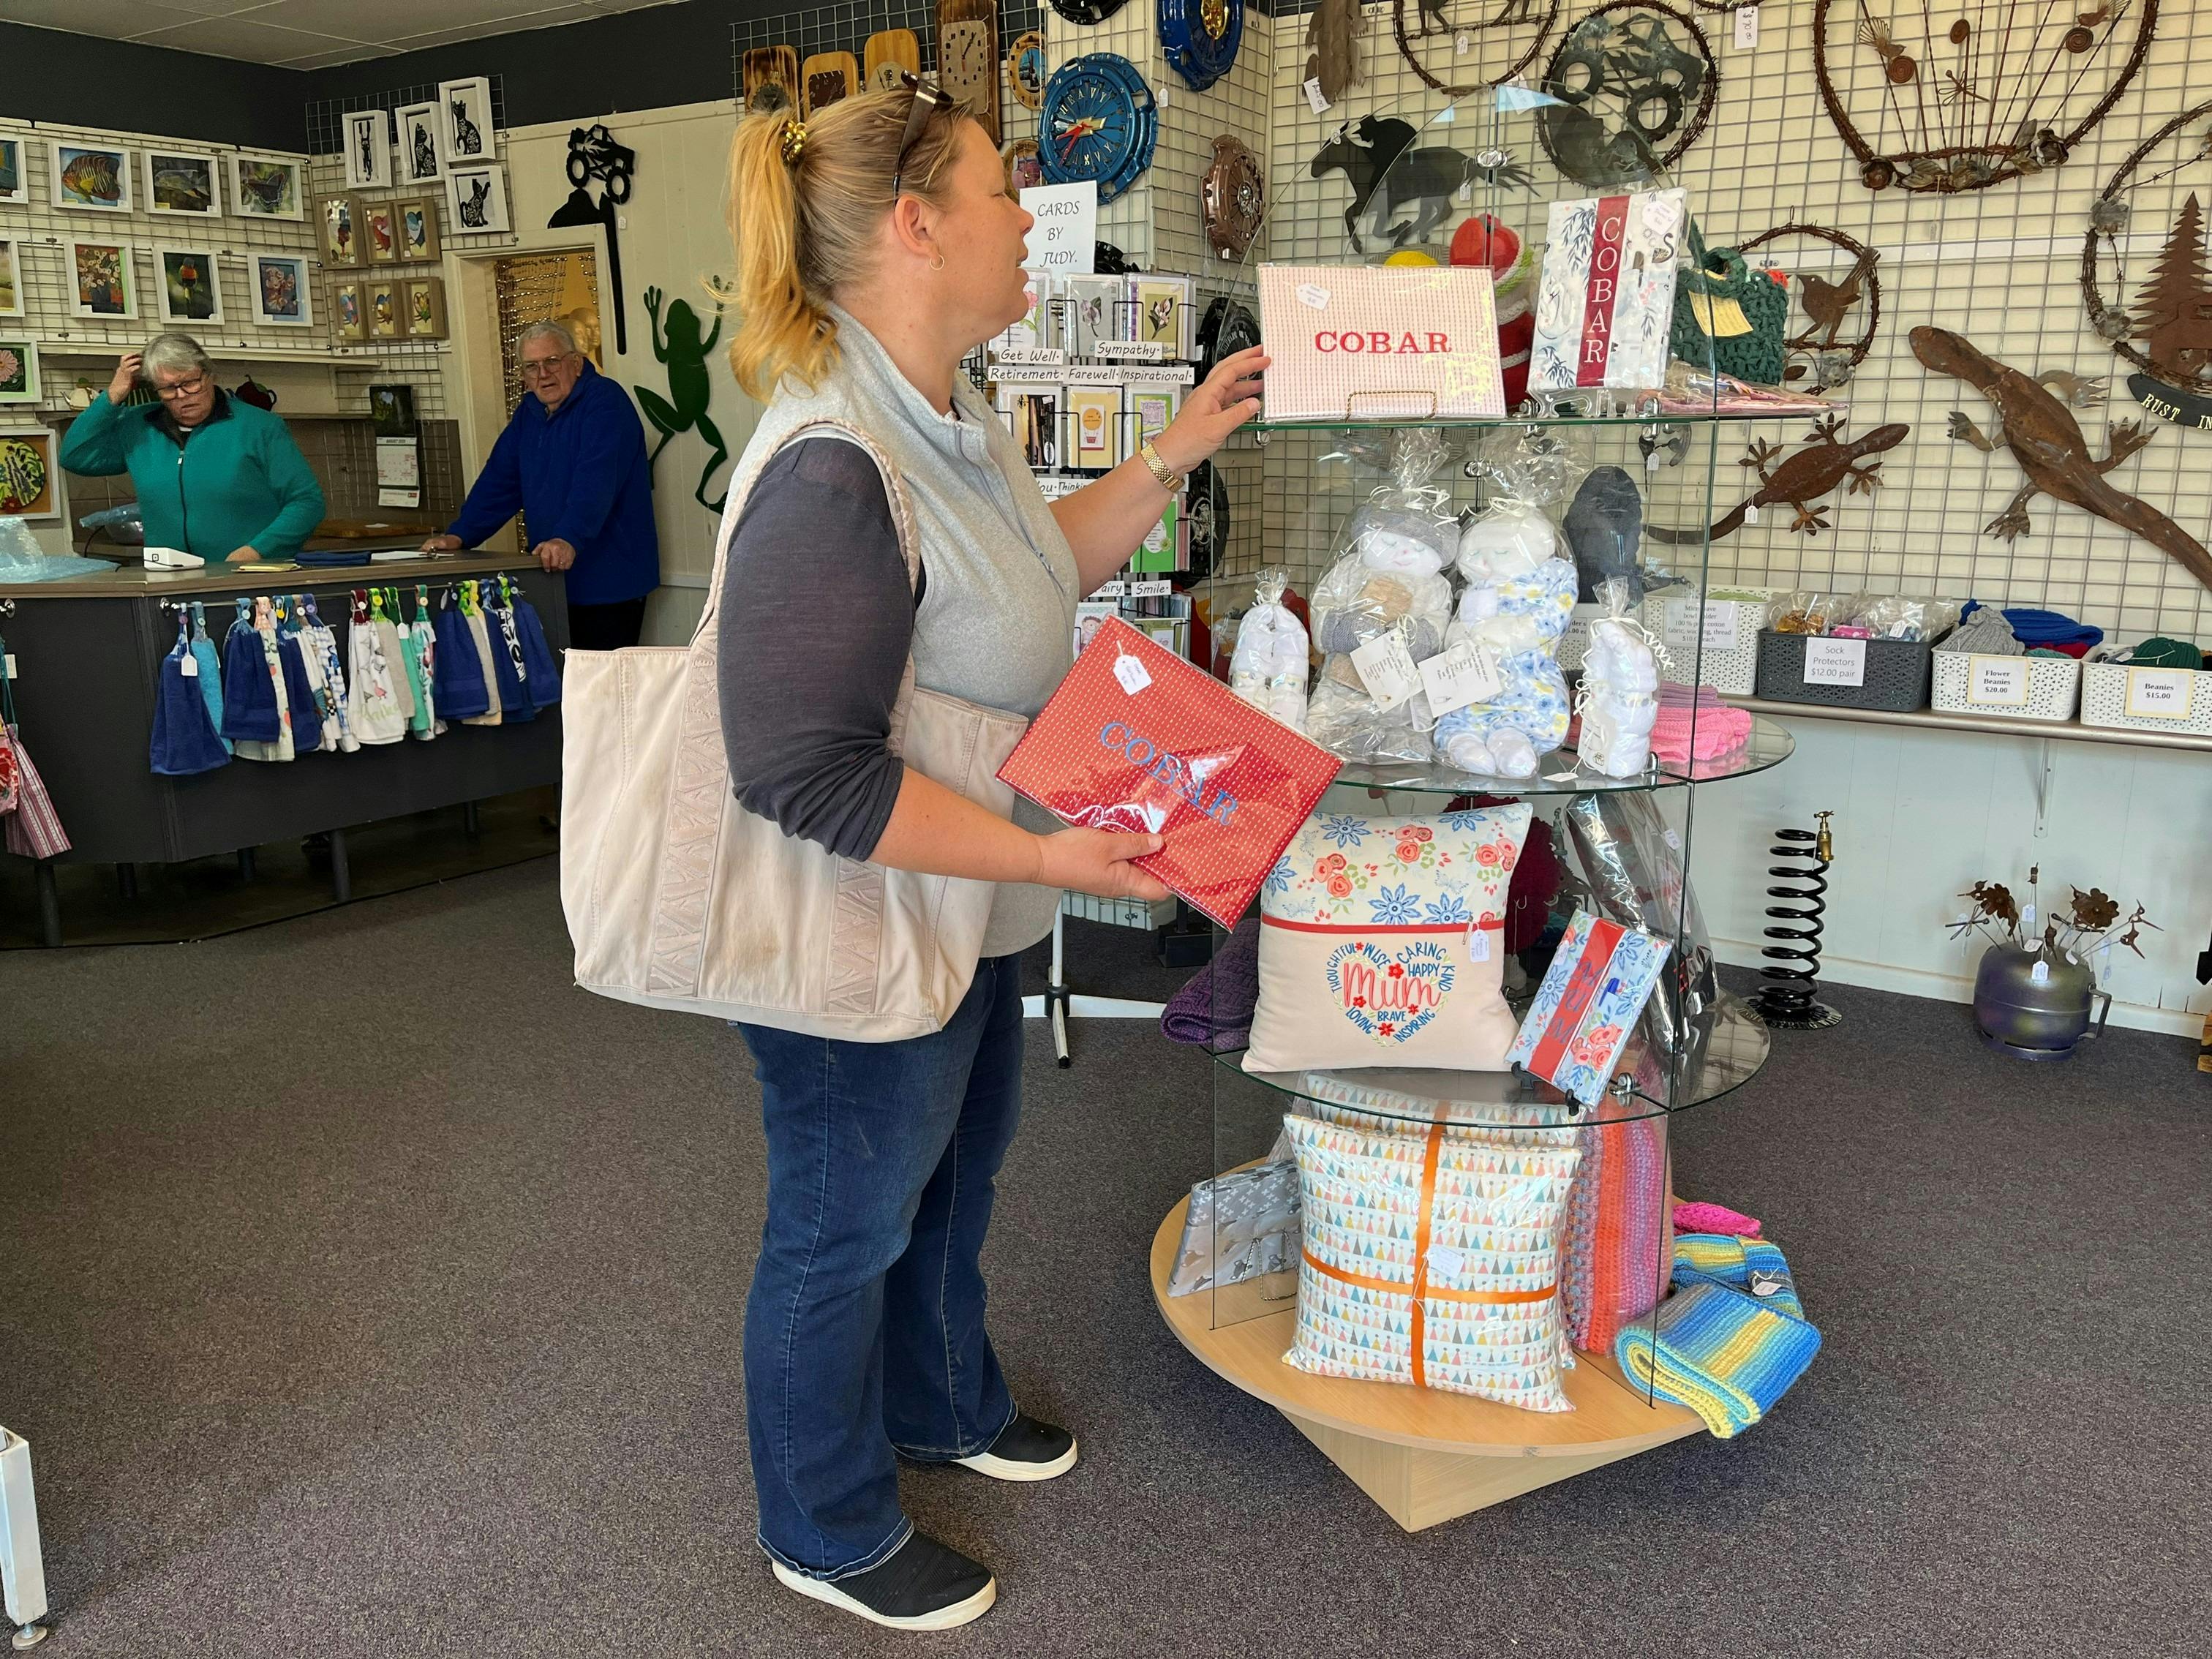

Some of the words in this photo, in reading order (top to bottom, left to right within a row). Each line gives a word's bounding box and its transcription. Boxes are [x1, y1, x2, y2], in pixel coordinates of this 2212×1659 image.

[1037, 200, 1080, 217] CARDS
[1047, 227, 1064, 241] BY
[1039, 250, 1077, 268] JUDY.
[1584, 217, 1622, 364] COBAR
[1314, 331, 1453, 354] COBAR
[1001, 349, 1023, 361] Get
[2141, 393, 2181, 422] RUST
[1102, 584, 1122, 595] airy
[1826, 646, 1844, 654] Sock
[1813, 657, 1855, 666] Protectors
[1811, 668, 1837, 677] $12.00
[1839, 670, 1856, 679] pair
[1099, 721, 1238, 826] COBAR
[1396, 941, 1447, 964] CARING
[1326, 942, 1356, 993] THOUGHTFUL
[1363, 942, 1391, 970] WISE
[1408, 963, 1440, 977] HAPPY
[1438, 965, 1456, 992] KIND
[1345, 1007, 1377, 1034] LOVING
[1377, 1011, 1407, 1022] BRAVE
[1393, 1008, 1436, 1043] INSPIRING
